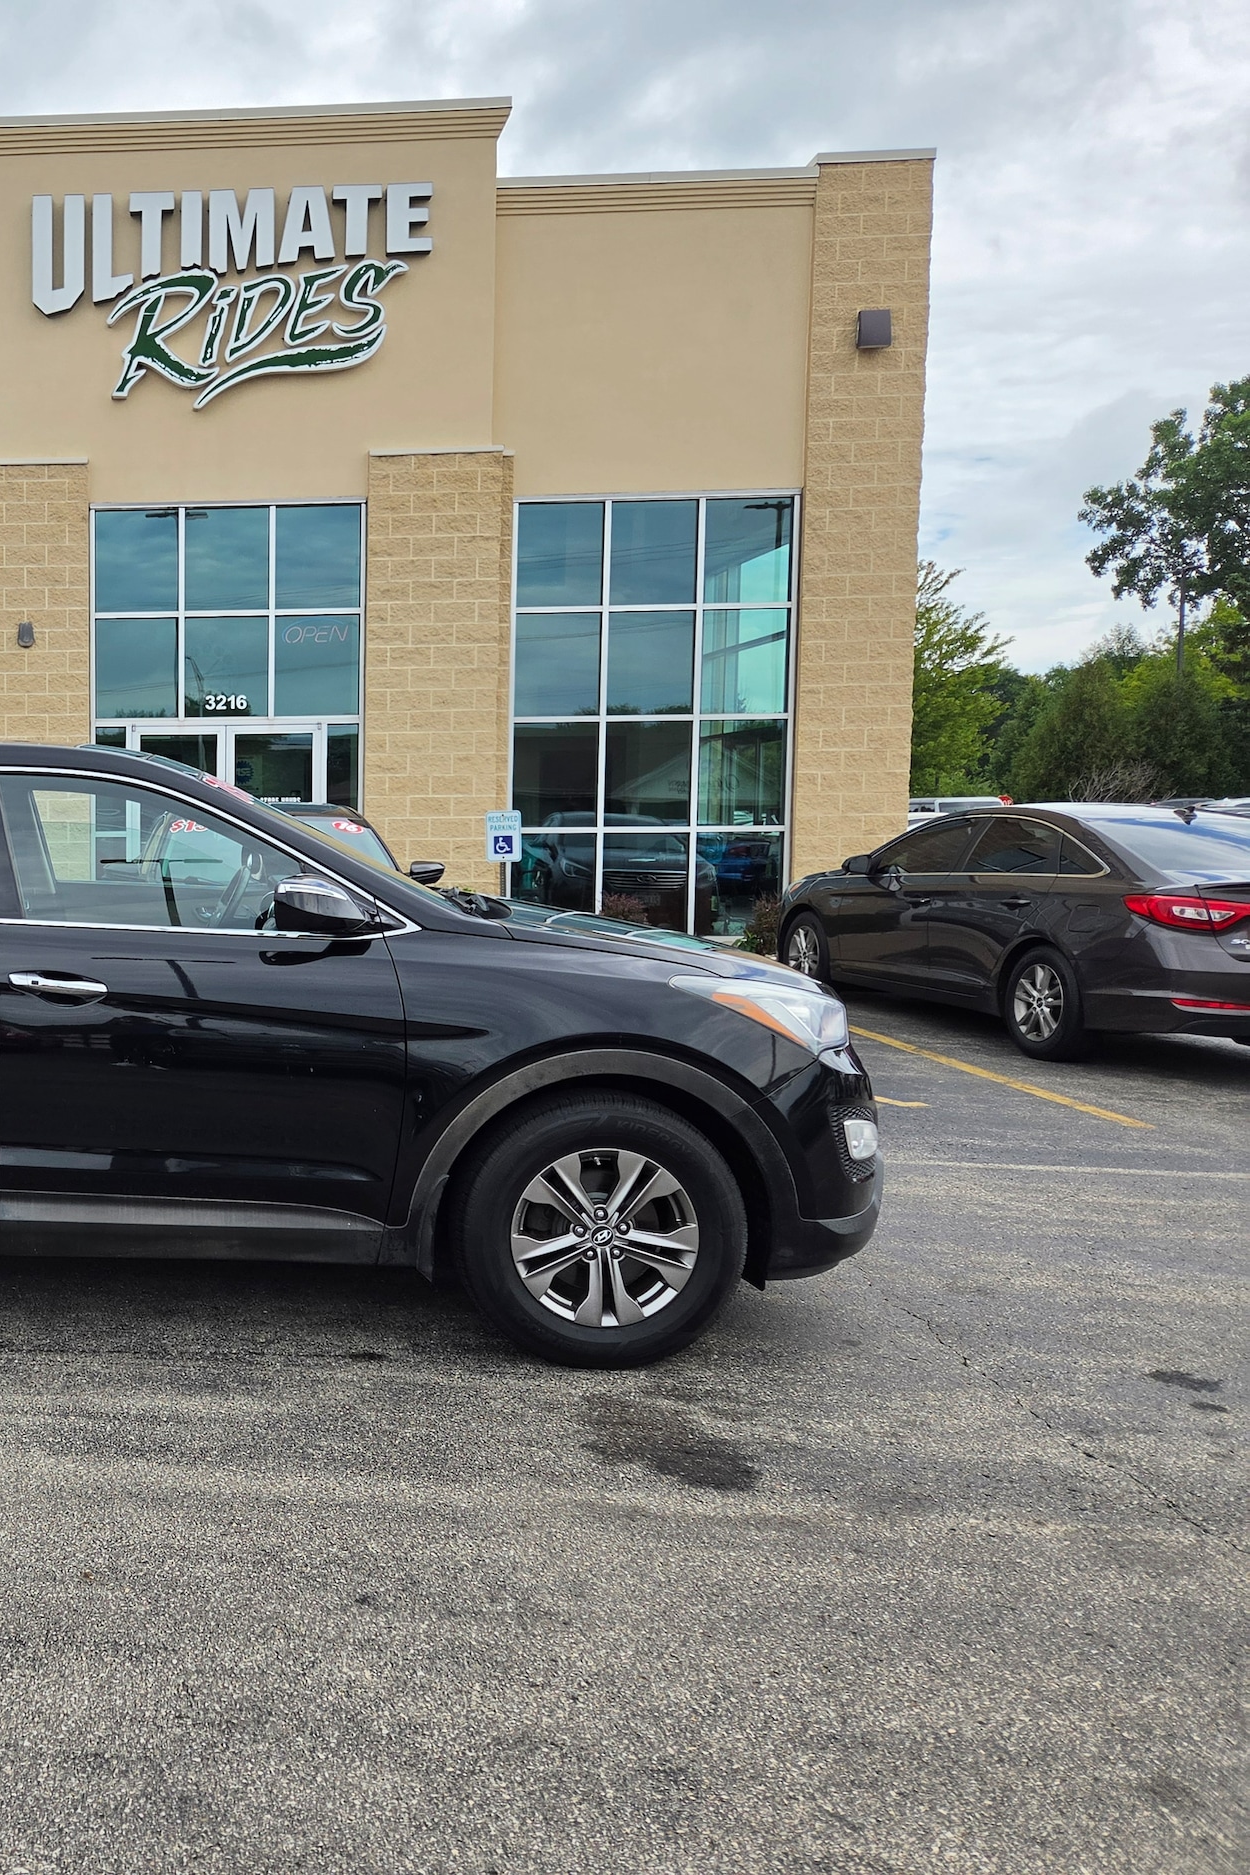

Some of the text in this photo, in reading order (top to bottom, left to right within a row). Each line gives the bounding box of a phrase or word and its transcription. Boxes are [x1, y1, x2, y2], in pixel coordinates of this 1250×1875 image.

[31, 181, 434, 317] ULTIMATE
[285, 624, 349, 643] OPEN
[204, 694, 248, 710] 3216
[487, 815, 519, 823] RESERVED
